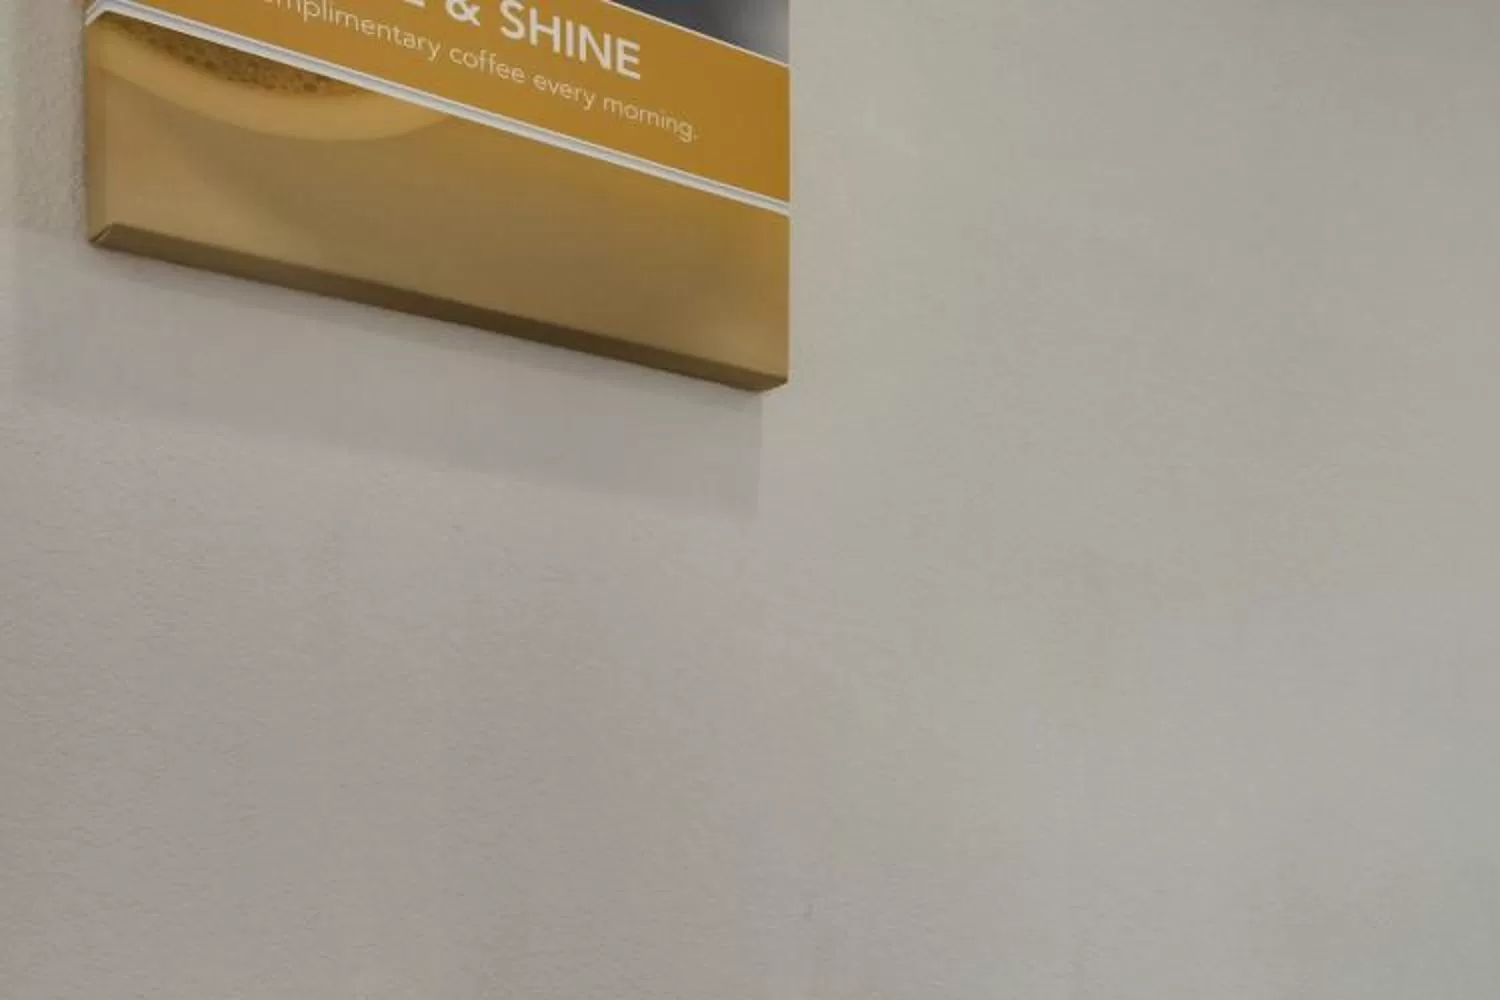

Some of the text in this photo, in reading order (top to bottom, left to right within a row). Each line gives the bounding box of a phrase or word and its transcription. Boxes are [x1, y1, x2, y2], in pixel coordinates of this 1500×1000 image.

[263, 0, 699, 143] mplimentary coffee every morning.
[500, 0, 641, 80] SHINE
